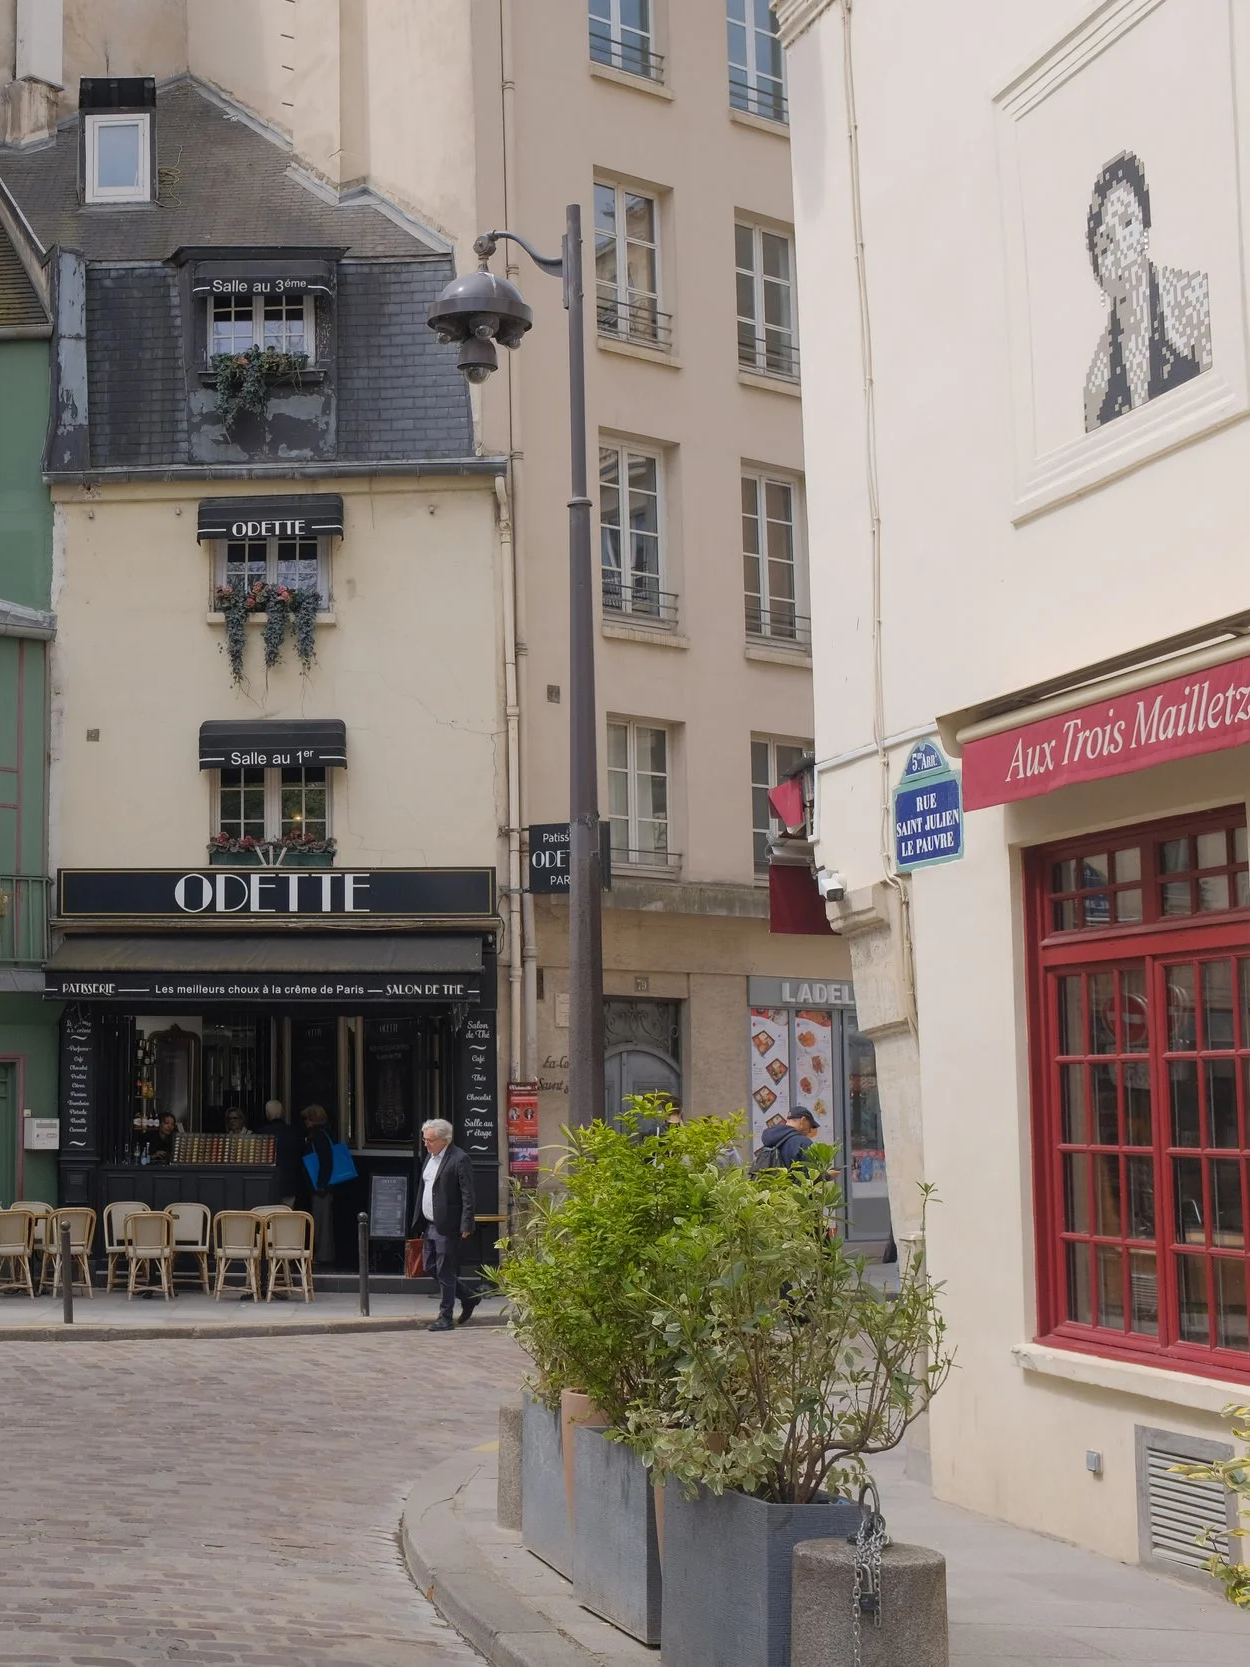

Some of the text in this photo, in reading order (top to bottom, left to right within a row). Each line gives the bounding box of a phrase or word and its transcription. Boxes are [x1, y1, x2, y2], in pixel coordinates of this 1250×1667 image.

[212, 279, 248, 293] Salle
[252, 282, 271, 293] au
[231, 520, 306, 537] ODETTE
[1005, 738, 1056, 782] Aux
[1061, 708, 1126, 766] Trois
[230, 750, 314, 765] Salle au 1er
[916, 793, 937, 812] RUE
[896, 808, 960, 838] SAINT JULIEN
[542, 832, 570, 843] Patiss
[901, 831, 954, 857] LE PAUVRE
[532, 850, 570, 869] ODE
[550, 875, 570, 886] PAR
[174, 873, 370, 913] ODETTE
[62, 983, 116, 996] PATISSERIE
[155, 984, 174, 994] Les
[177, 984, 225, 994] meilleurs
[228, 984, 260, 994] choux
[262, 984, 269, 994] à
[272, 984, 281, 994] la
[320, 984, 333, 994] de
[336, 984, 364, 994] Paris
[385, 984, 422, 995] SALON
[425, 984, 439, 995] DE
[467, 1020, 489, 1029] Salon
[465, 1030, 490, 1039] de Thé
[471, 1054, 486, 1064] Café
[466, 1093, 492, 1101] Chocolat
[464, 1118, 483, 1127] Salle
